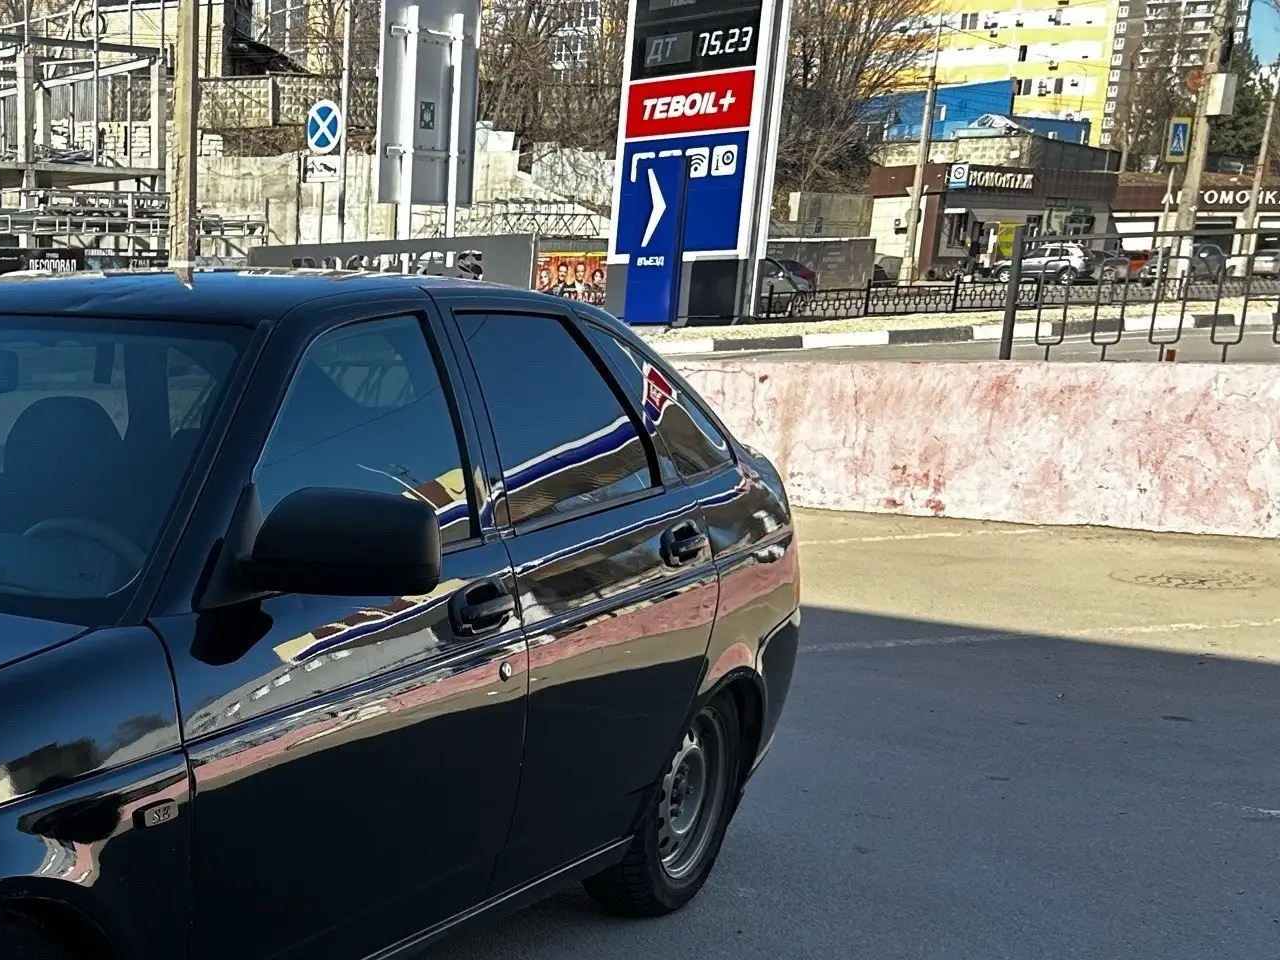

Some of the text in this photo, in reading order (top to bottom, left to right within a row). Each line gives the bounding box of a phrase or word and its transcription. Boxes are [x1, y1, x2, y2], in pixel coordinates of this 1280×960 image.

[646, 26, 754, 64] ДТ 75.23
[29, 259, 77, 271] ЛЕСОПОВАЛ
[636, 255, 665, 267] ВЪЕЗД
